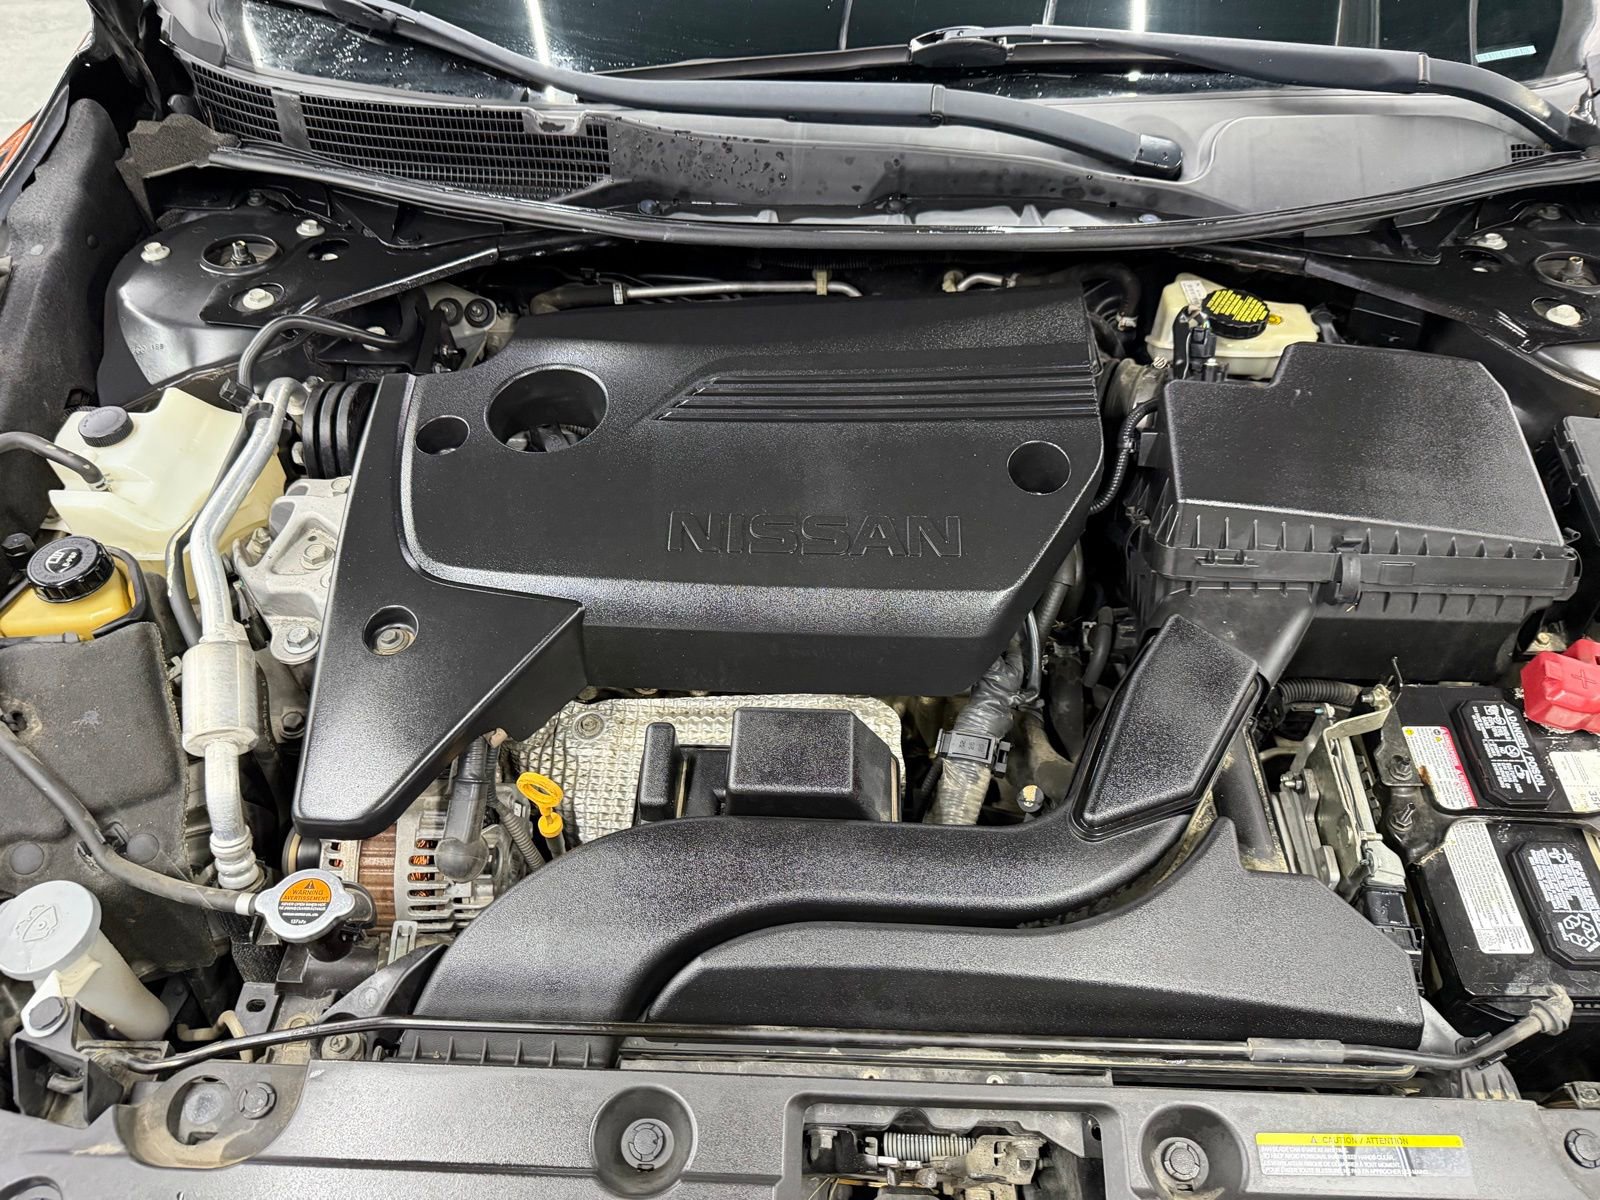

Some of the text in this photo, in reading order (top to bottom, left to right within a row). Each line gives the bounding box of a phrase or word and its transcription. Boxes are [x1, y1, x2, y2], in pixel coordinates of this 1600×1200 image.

[667, 511, 963, 557] NISSAN
[1508, 717, 1529, 747] DANGER
[1526, 756, 1546, 785] POISON
[1322, 1136, 1358, 1145] CAUTION
[1366, 1138, 1408, 1146] ATTENTION
